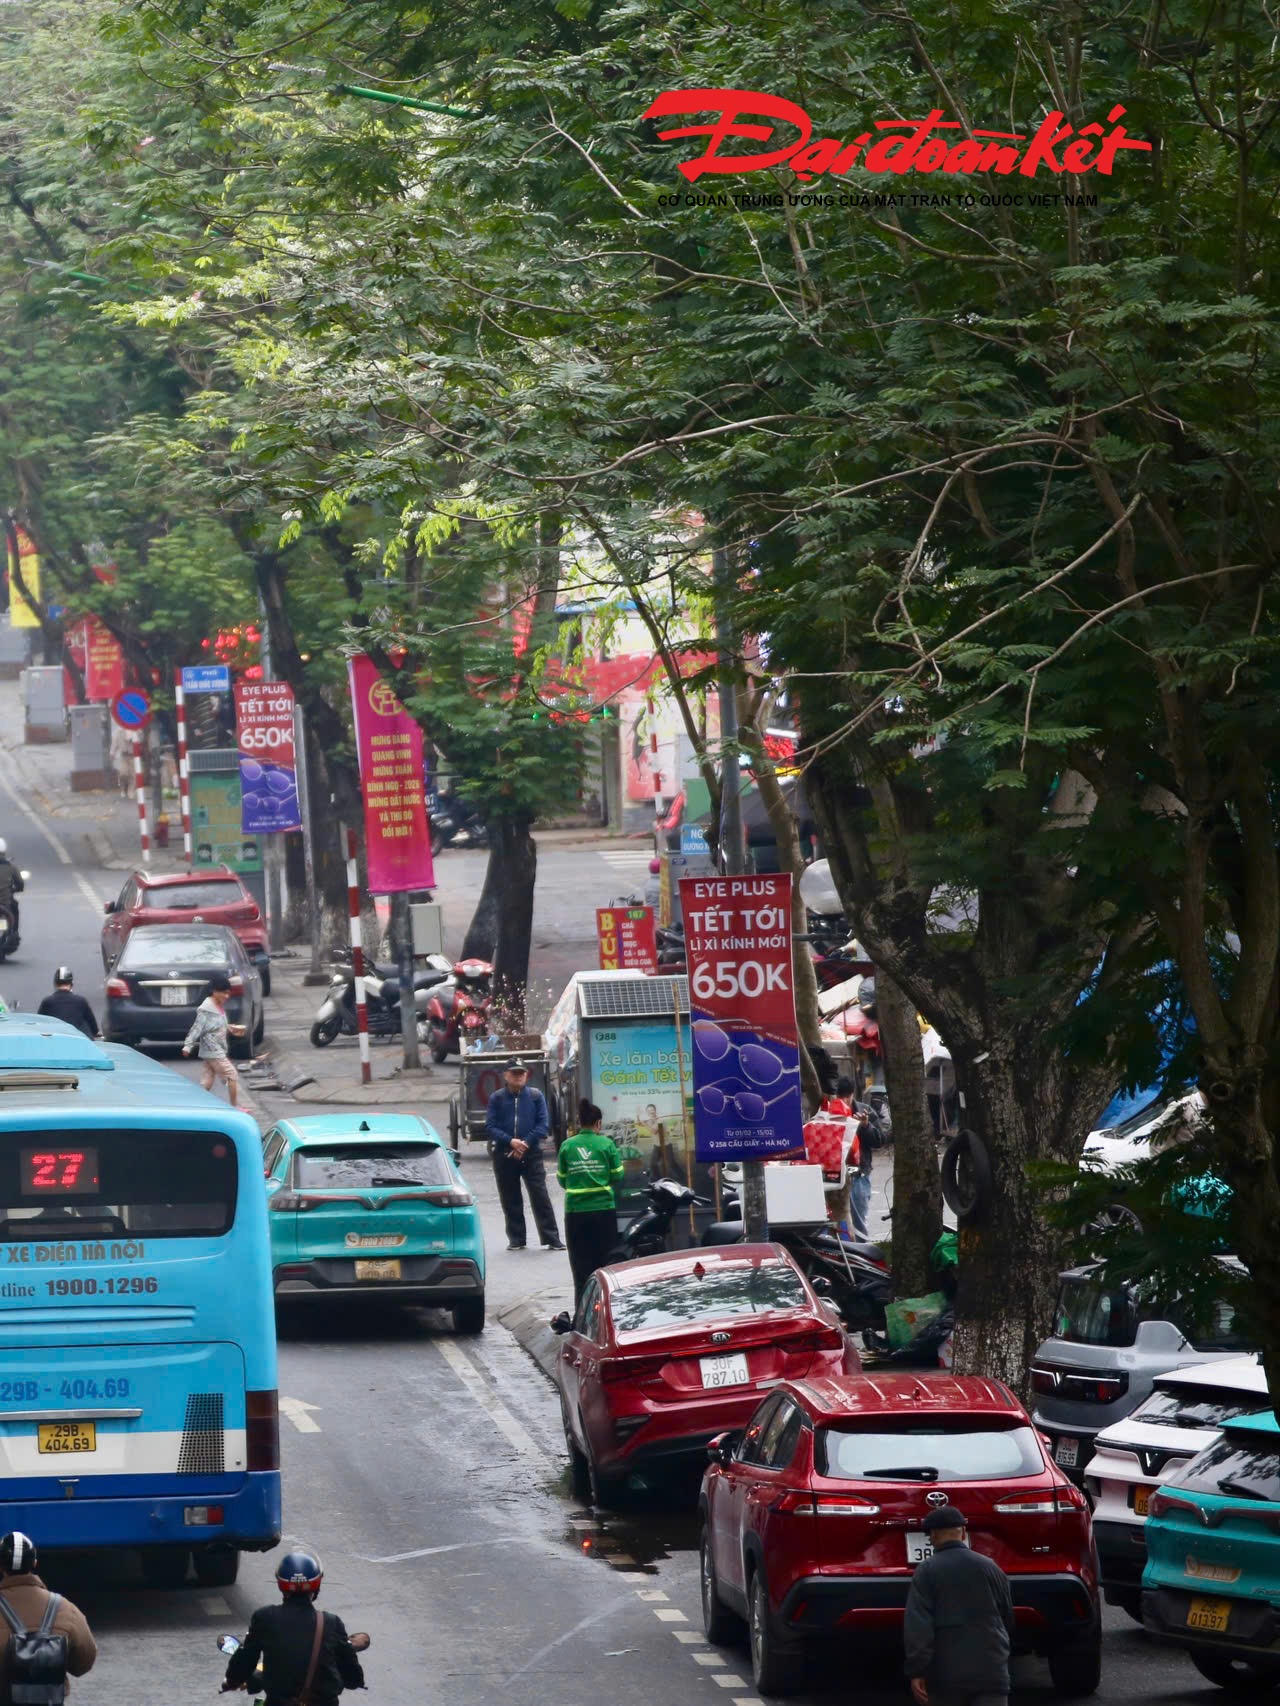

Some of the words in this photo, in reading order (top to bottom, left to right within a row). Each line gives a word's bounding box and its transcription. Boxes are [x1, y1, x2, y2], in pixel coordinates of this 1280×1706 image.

[242, 686, 259, 696] EYE
[262, 685, 287, 694] PLUS
[240, 727, 294, 749] 650K
[695, 883, 727, 898] EYE
[731, 881, 775, 896] PLUS
[689, 904, 734, 932] TẾT
[740, 904, 785, 931] TỚI
[690, 936, 700, 951] LÌ
[704, 937, 717, 950] XÌ
[721, 936, 754, 950] KÍNH
[758, 934, 786, 949] MỚI
[692, 961, 789, 999] 650K
[600, 1052, 621, 1066] Xe
[32, 1153, 84, 1186] 27
[8, 1246, 29, 1263] XE
[35, 1241, 77, 1266] ĐIỆN
[82, 1240, 106, 1261] HÀ
[45, 1276, 158, 1296] 1900.1296
[712, 1358, 733, 1370] 30F
[703, 1369, 746, 1386] 787.10
[0, 1381, 38, 1402] 29B
[60, 1378, 130, 1399] 404.69
[45, 1438, 90, 1451] 404.69
